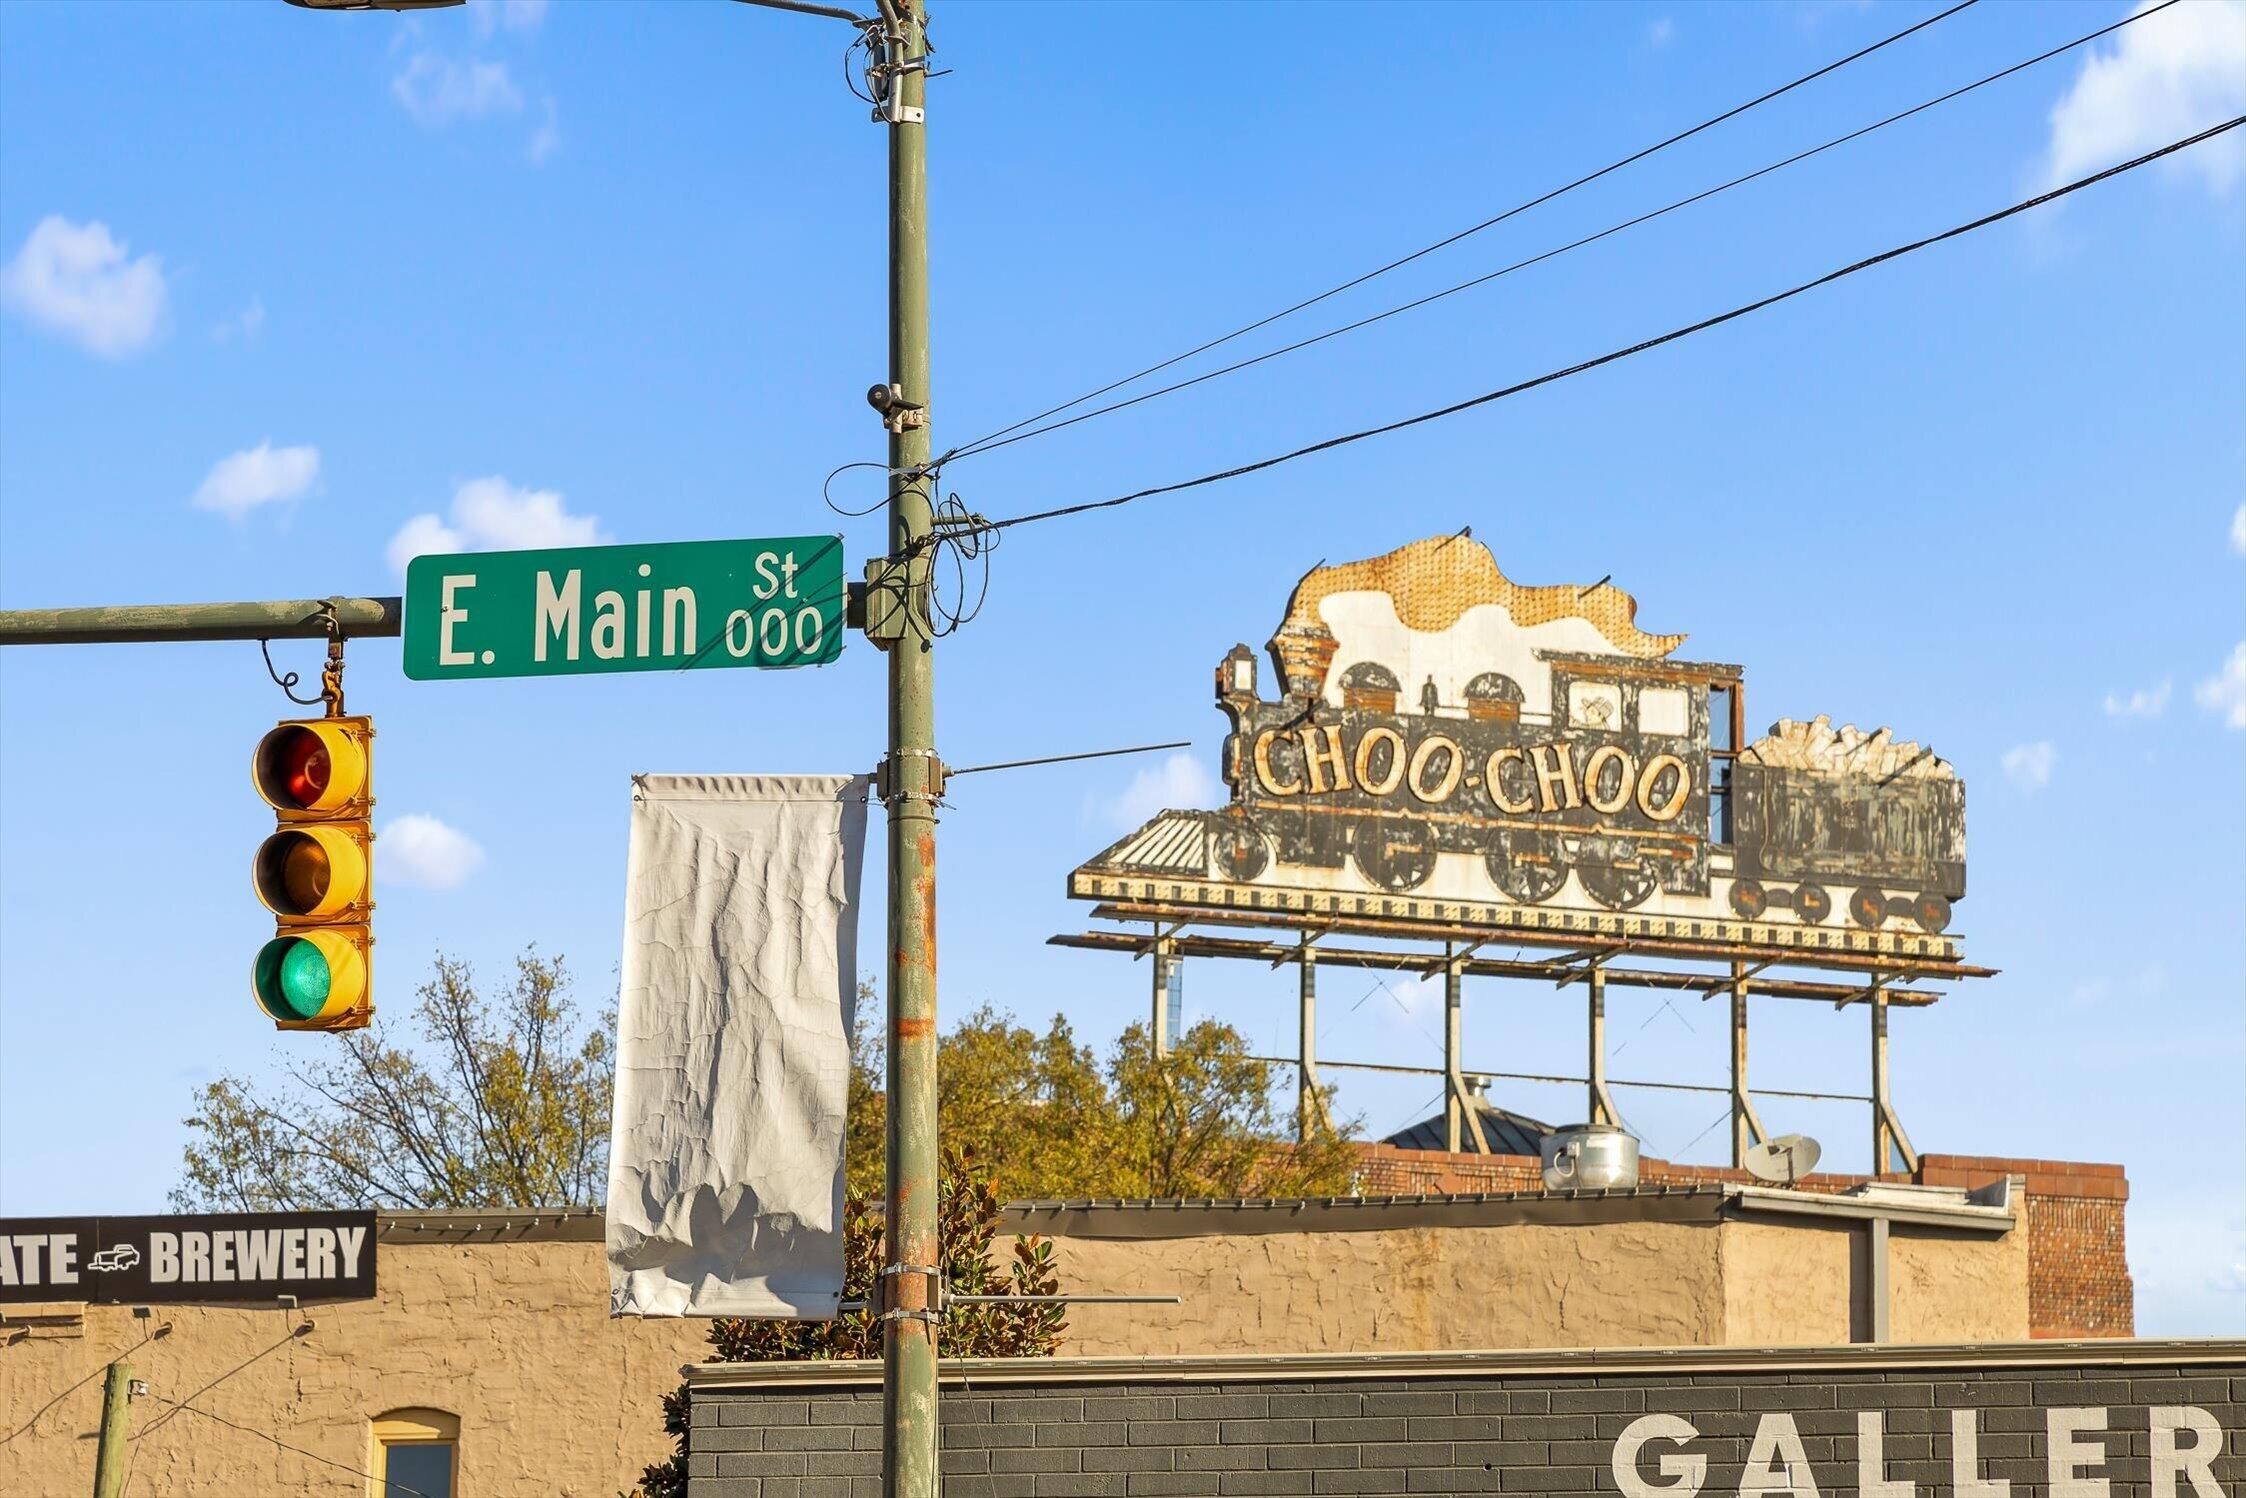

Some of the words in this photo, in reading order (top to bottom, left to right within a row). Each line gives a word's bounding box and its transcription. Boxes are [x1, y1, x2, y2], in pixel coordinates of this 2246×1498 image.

[441, 575, 496, 665] E.
[535, 564, 697, 662] Main
[752, 551, 799, 600] St
[725, 606, 824, 658] 000
[1253, 725, 1691, 821] CHOO-CHOO
[150, 1227, 366, 1283] BREWERY
[1611, 1406, 2227, 1498] GALLER
